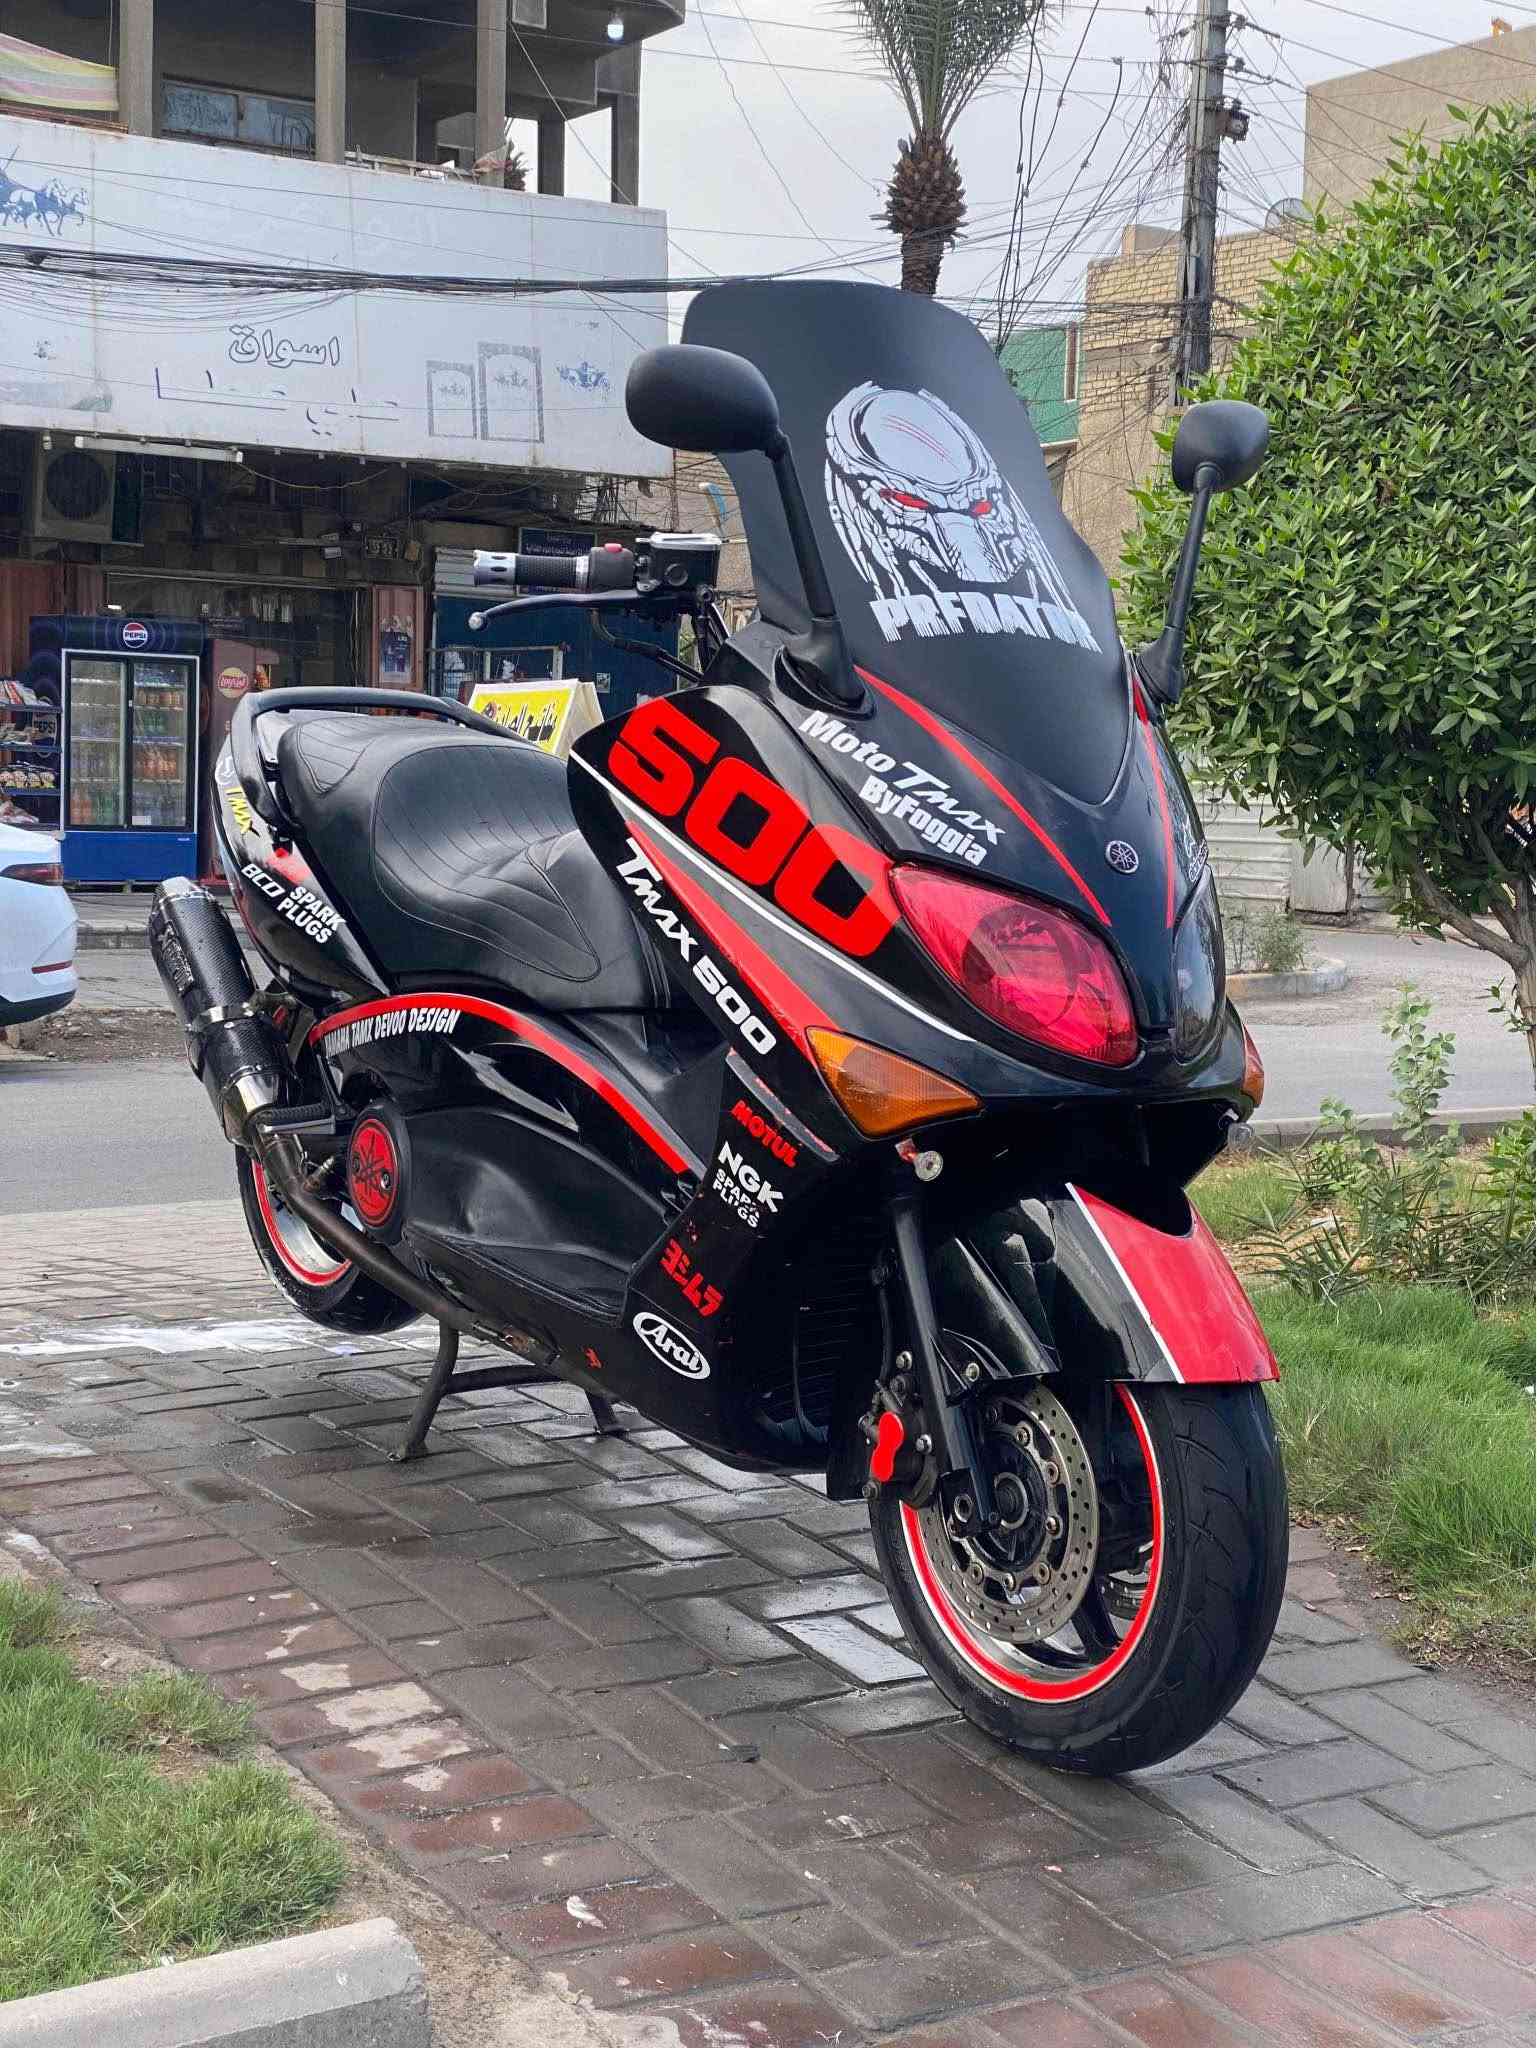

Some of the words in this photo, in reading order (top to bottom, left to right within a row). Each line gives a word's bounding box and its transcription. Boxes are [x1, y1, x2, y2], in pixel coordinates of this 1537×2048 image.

[229, 324, 341, 369] اسواق
[124, 631, 147, 640] PEPSI
[798, 709, 897, 773] Moto
[607, 697, 900, 957] 500
[858, 775, 988, 867] ByFoggia
[276, 897, 333, 944] PLUGS
[290, 886, 347, 932] SPARK
[615, 836, 699, 963] TMAX
[692, 954, 777, 1055] 500
[408, 1007, 461, 1035] DESIGN
[731, 1099, 799, 1169] MOTUL
[717, 1140, 784, 1213] NGK
[641, 1323, 701, 1371] Arai
